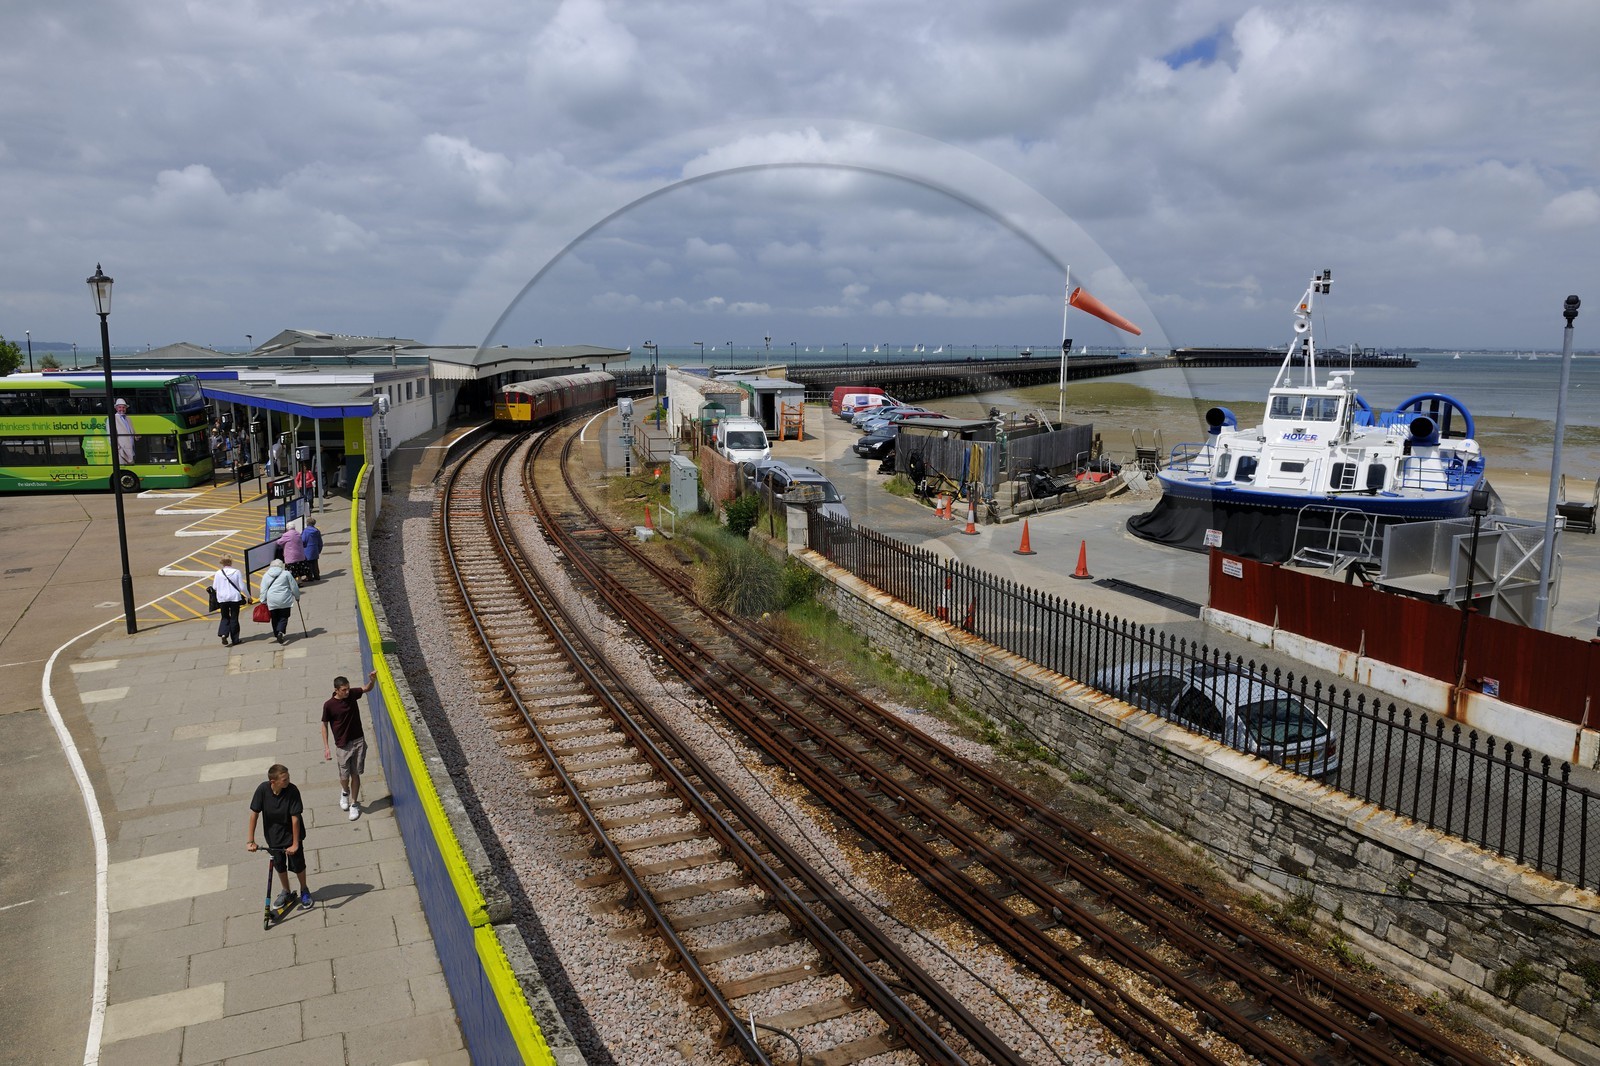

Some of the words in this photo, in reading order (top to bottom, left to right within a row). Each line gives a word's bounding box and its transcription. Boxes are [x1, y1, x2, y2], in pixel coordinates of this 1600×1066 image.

[32, 421, 51, 430] think
[53, 421, 78, 430] island
[81, 421, 106, 430] buses
[1283, 433, 1318, 441] HOVER
[274, 486, 279, 497] H
